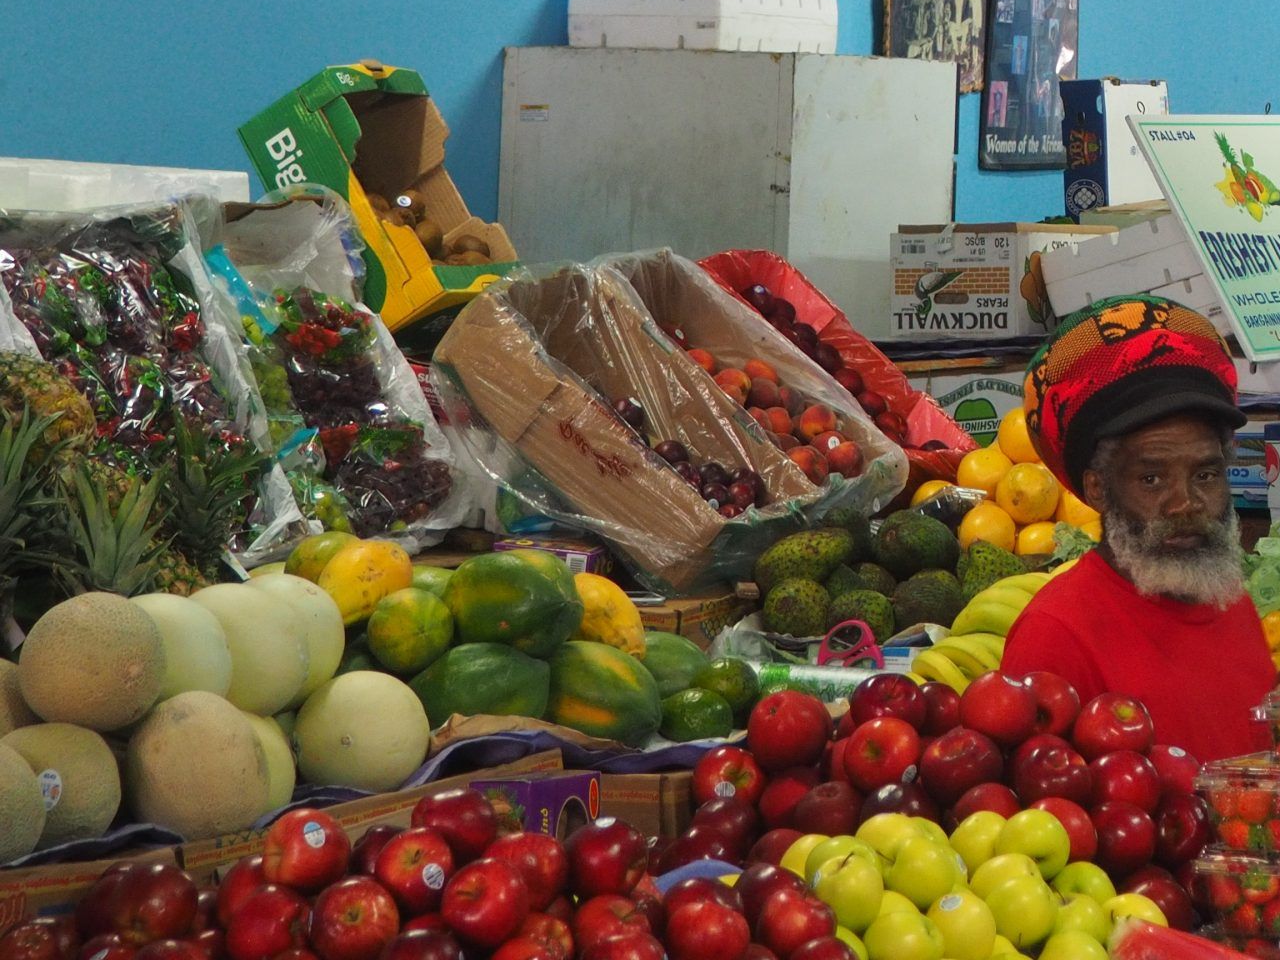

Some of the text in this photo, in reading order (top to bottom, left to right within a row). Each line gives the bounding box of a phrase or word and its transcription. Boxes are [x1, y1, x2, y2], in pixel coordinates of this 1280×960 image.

[985, 134, 1017, 154] Women
[1018, 133, 1028, 155] of
[1028, 135, 1040, 154] the
[265, 127, 308, 191] Big
[995, 237, 1010, 248] 120
[1199, 230, 1278, 280] FRESHEST
[976, 297, 1009, 308] PEARS
[893, 312, 1008, 330] DUCKWALL
